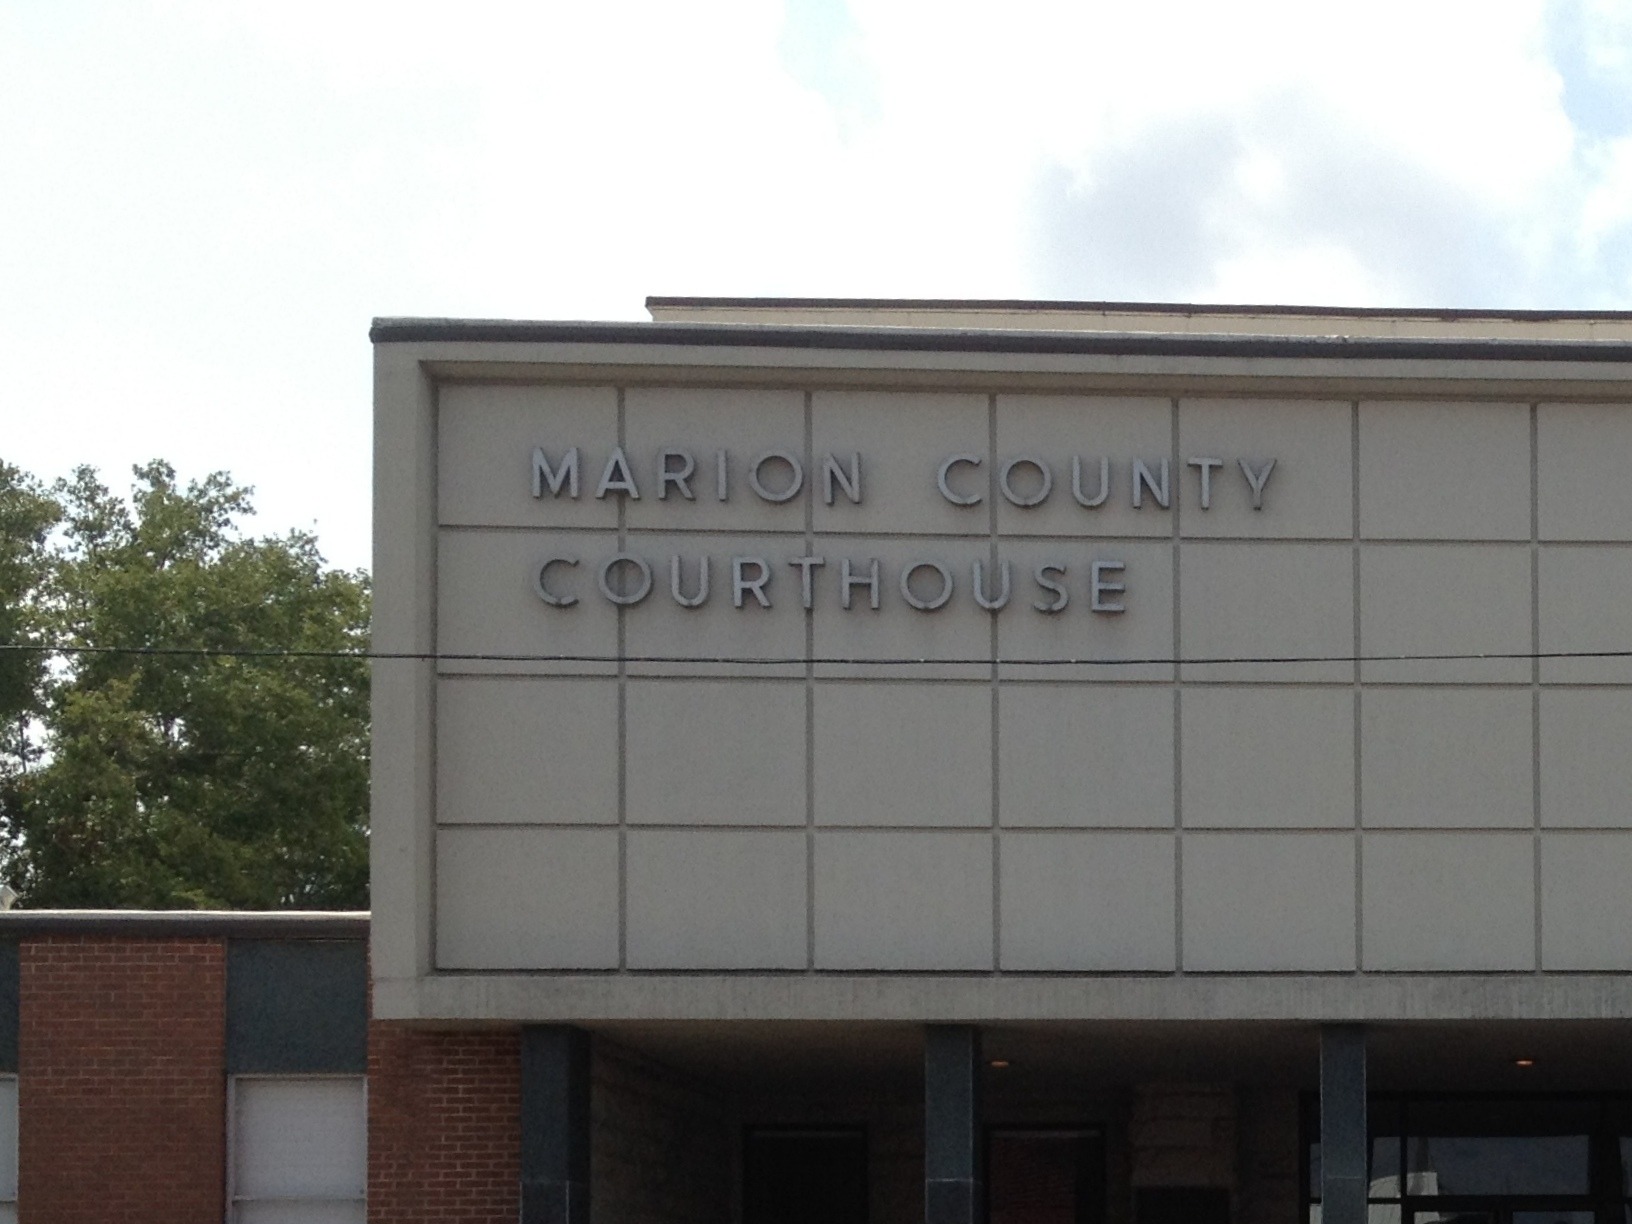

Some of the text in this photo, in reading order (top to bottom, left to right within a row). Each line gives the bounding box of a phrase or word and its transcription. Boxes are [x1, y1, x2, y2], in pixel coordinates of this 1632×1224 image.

[531, 446, 1278, 511] MARION COUNTY
[533, 550, 1127, 614] COURTHOUSE
